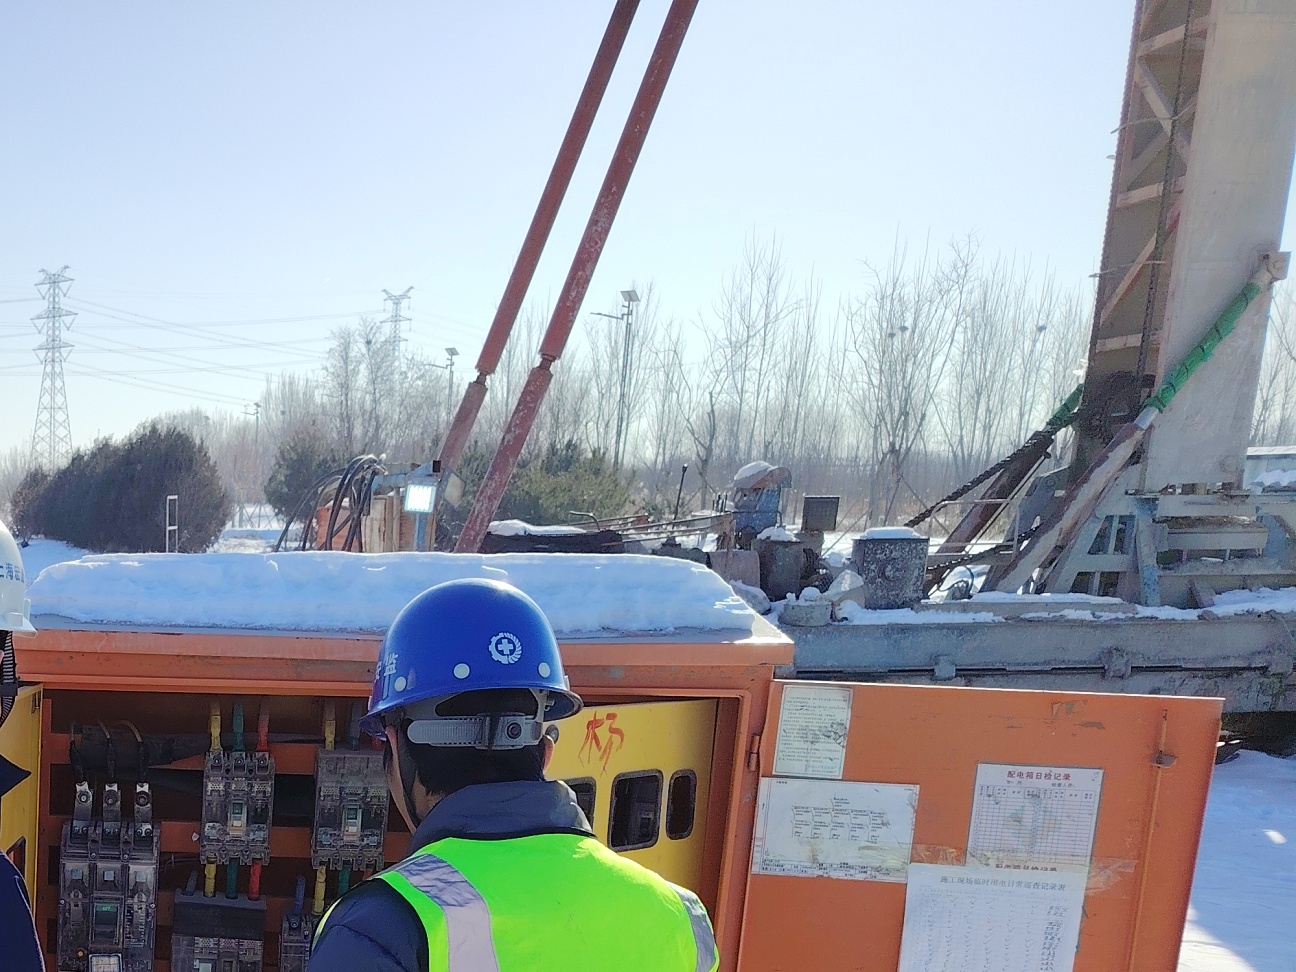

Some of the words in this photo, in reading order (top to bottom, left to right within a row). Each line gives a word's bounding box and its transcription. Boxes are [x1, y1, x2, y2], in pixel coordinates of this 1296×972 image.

[1007, 770, 1071, 781] 配电箱日检记录
[940, 875, 1066, 891] 施工现场临时用电日常巡查记录表
